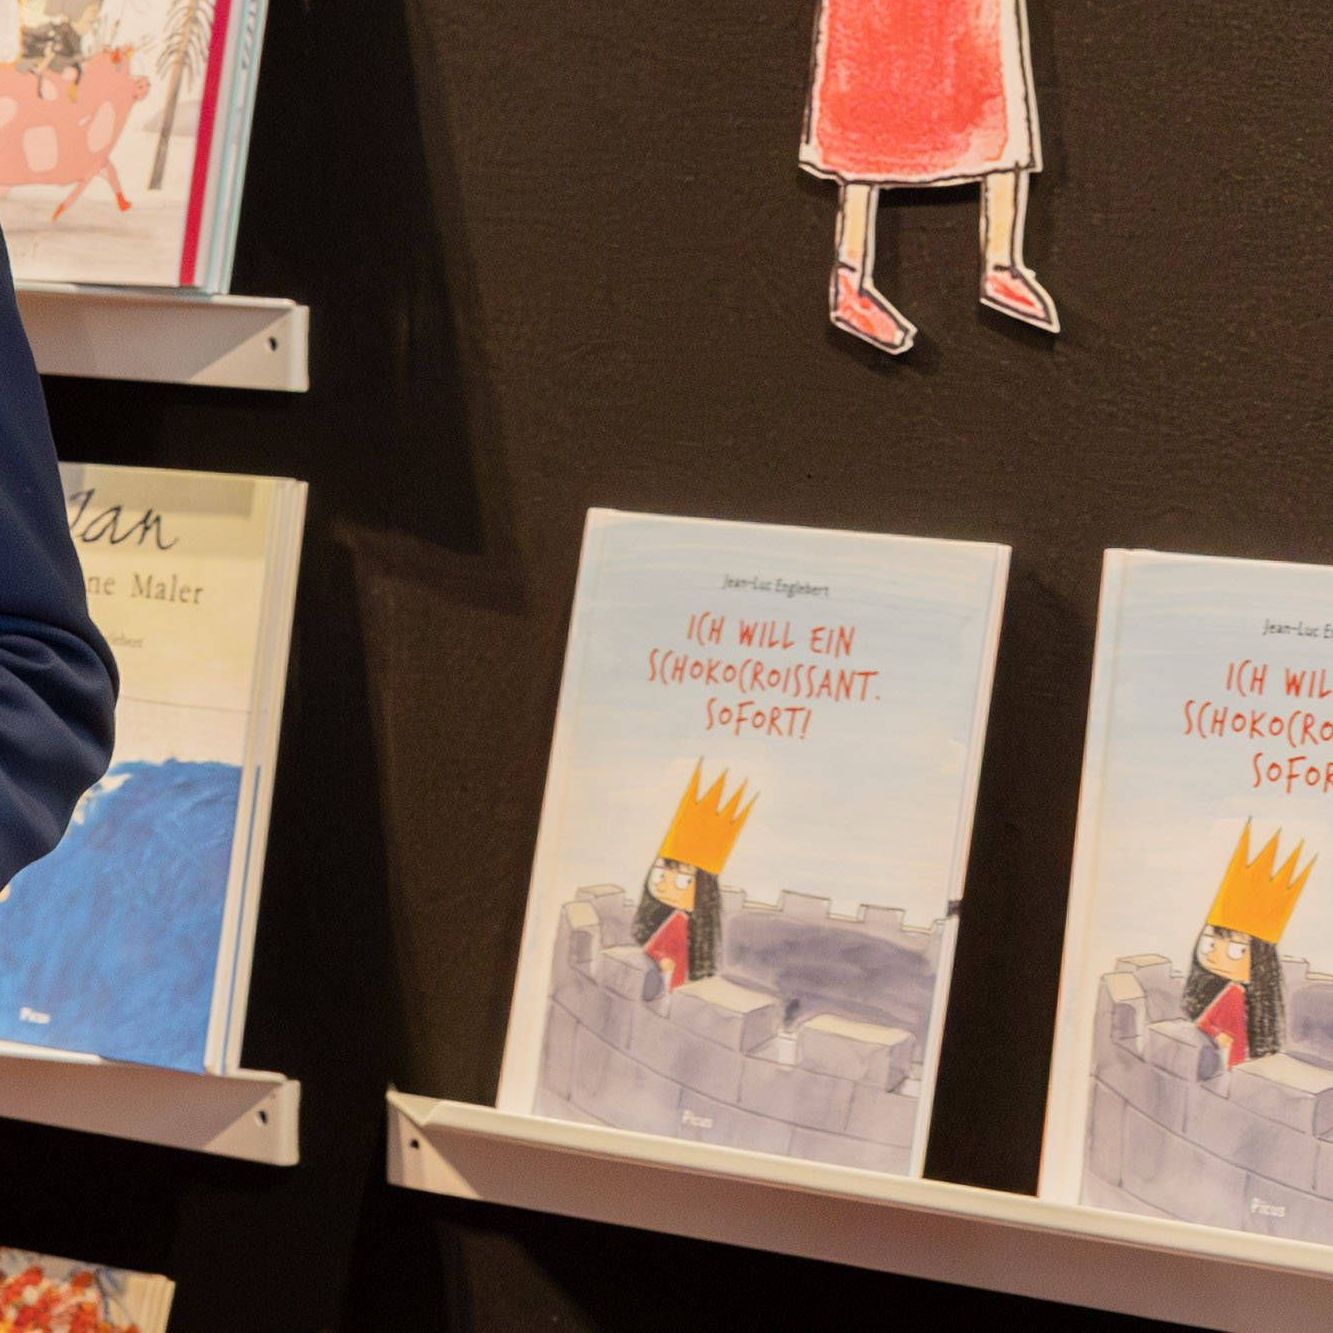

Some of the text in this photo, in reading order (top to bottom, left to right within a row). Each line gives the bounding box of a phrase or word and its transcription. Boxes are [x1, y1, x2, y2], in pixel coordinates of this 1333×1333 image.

[131, 573, 205, 605] Maler
[722, 575, 772, 592] Jean-Luc
[687, 611, 856, 659] ICH WILL EIN
[1262, 618, 1320, 638] Jean-Luc
[649, 648, 881, 702] SCHOKOCROISSANT.
[1225, 659, 1269, 698] ICH
[705, 697, 813, 740] SOFORT!
